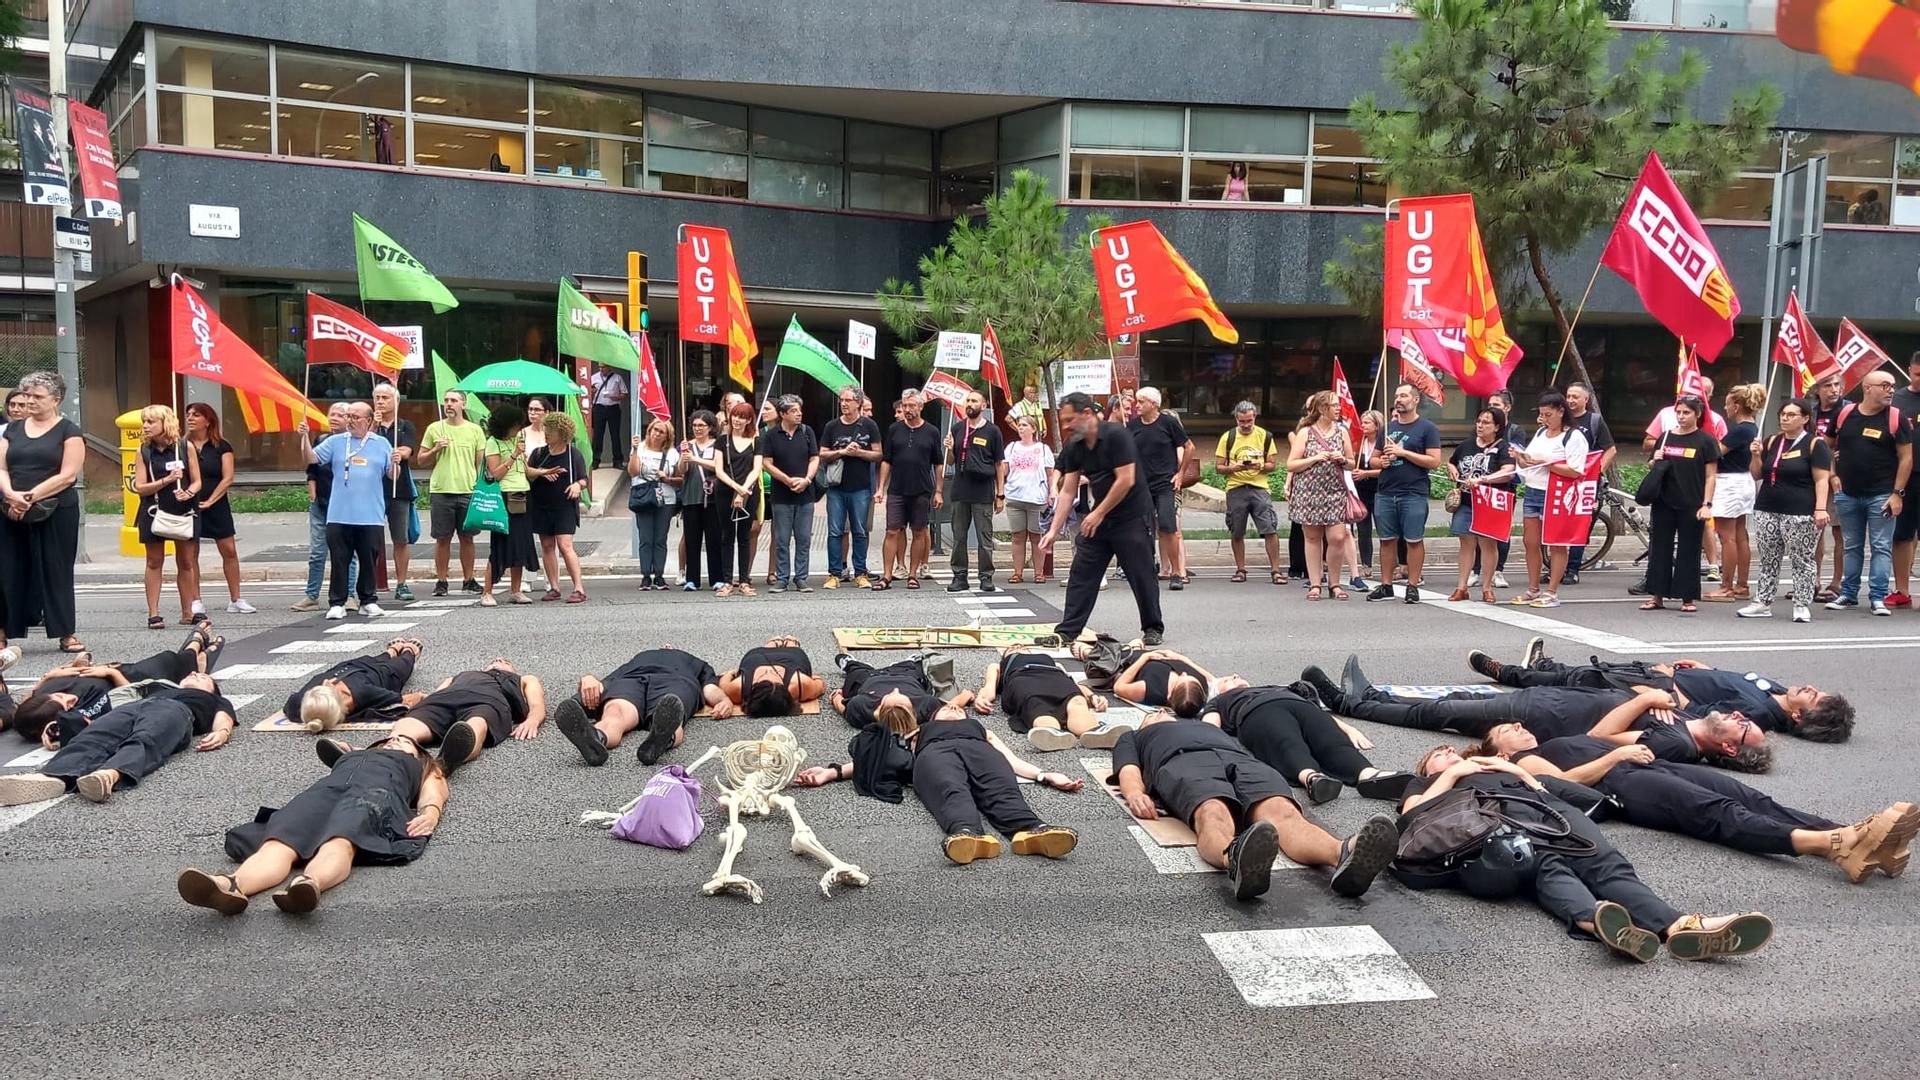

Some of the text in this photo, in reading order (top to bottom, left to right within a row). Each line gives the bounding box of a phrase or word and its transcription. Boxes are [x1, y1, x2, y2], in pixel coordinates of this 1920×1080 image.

[197, 222, 233, 231] AUGUSTA
[1639, 199, 1707, 282] CCOO
[1407, 210, 1434, 307] UGT
[692, 236, 715, 322] UGT
[1107, 235, 1139, 315] UGT
[1121, 313, 1146, 328] .cat
[1403, 308, 1433, 320] .cat
[317, 318, 377, 353] CCOO
[694, 323, 718, 335] .cat
[192, 362, 223, 374] .cat
